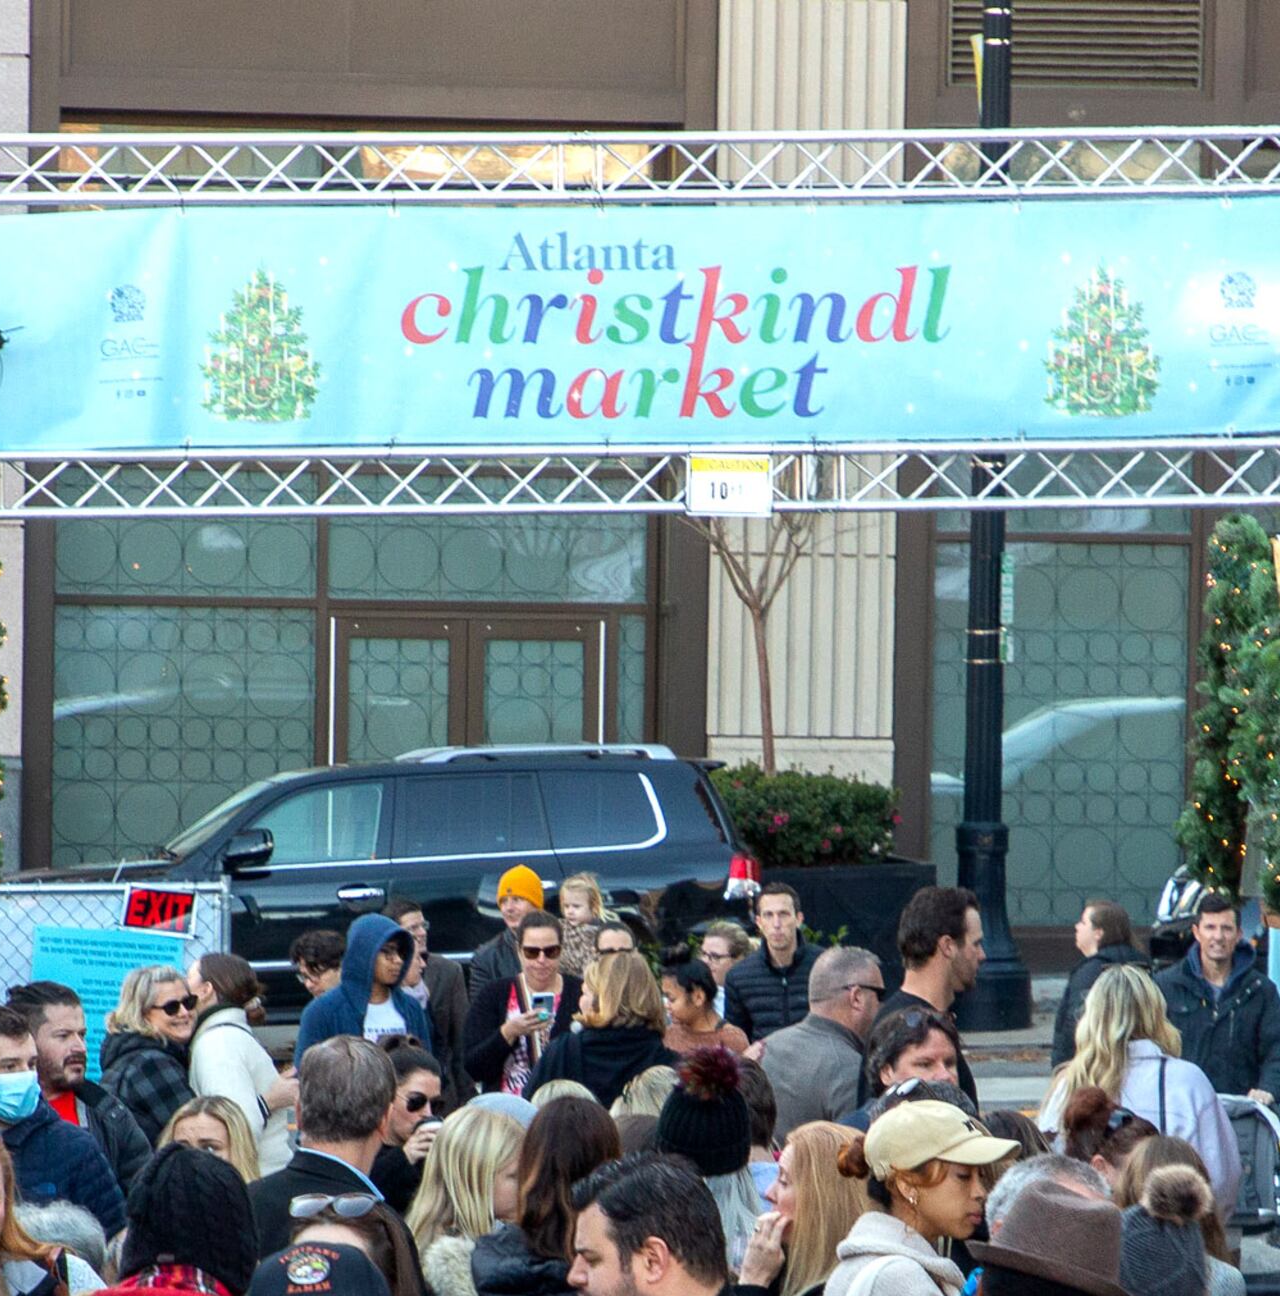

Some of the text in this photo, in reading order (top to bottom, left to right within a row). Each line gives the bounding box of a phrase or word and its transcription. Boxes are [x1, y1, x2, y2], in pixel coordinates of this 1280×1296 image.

[499, 231, 676, 271] Atlanta
[400, 264, 952, 346] christkindl
[467, 346, 828, 420] market
[124, 889, 192, 931] EXIT
